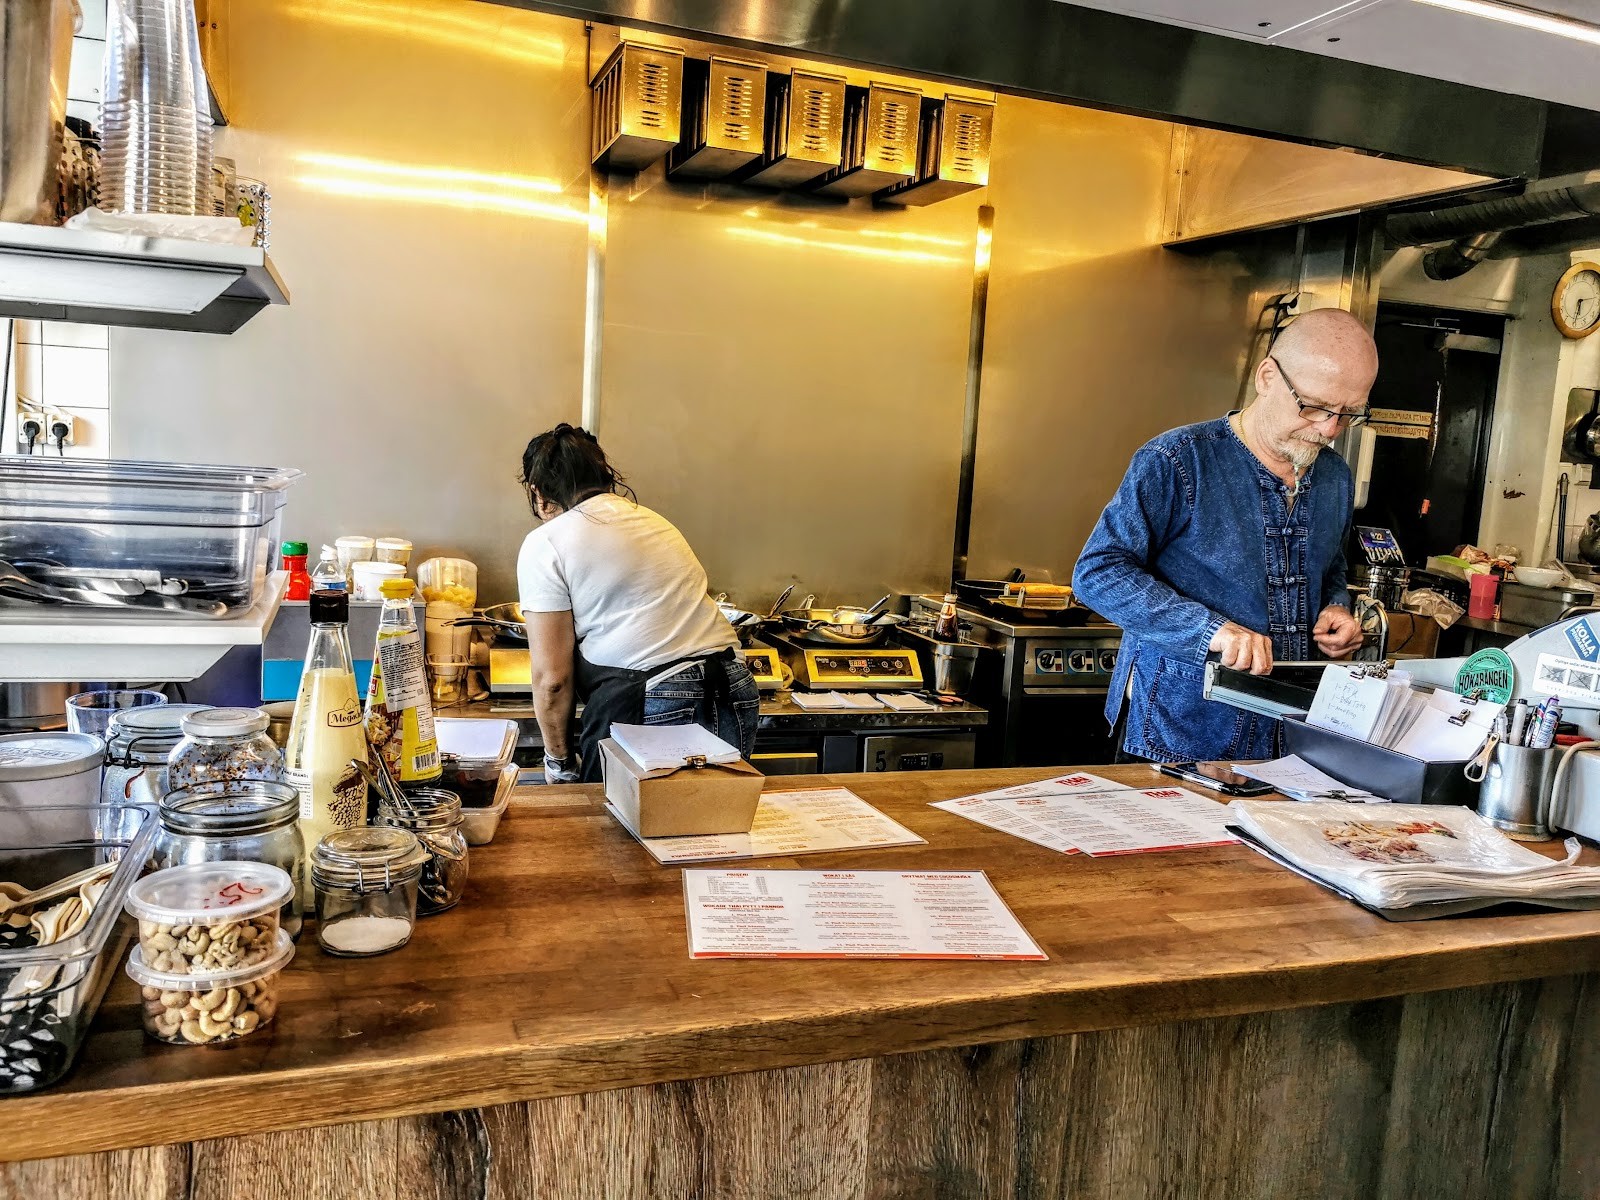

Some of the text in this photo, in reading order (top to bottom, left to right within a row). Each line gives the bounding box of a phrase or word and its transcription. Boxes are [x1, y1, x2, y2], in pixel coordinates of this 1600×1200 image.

[1573, 622, 1596, 655] KOLLA
[1459, 669, 1509, 693] HÖKARÄNGEN
[875, 750, 887, 771] 5
